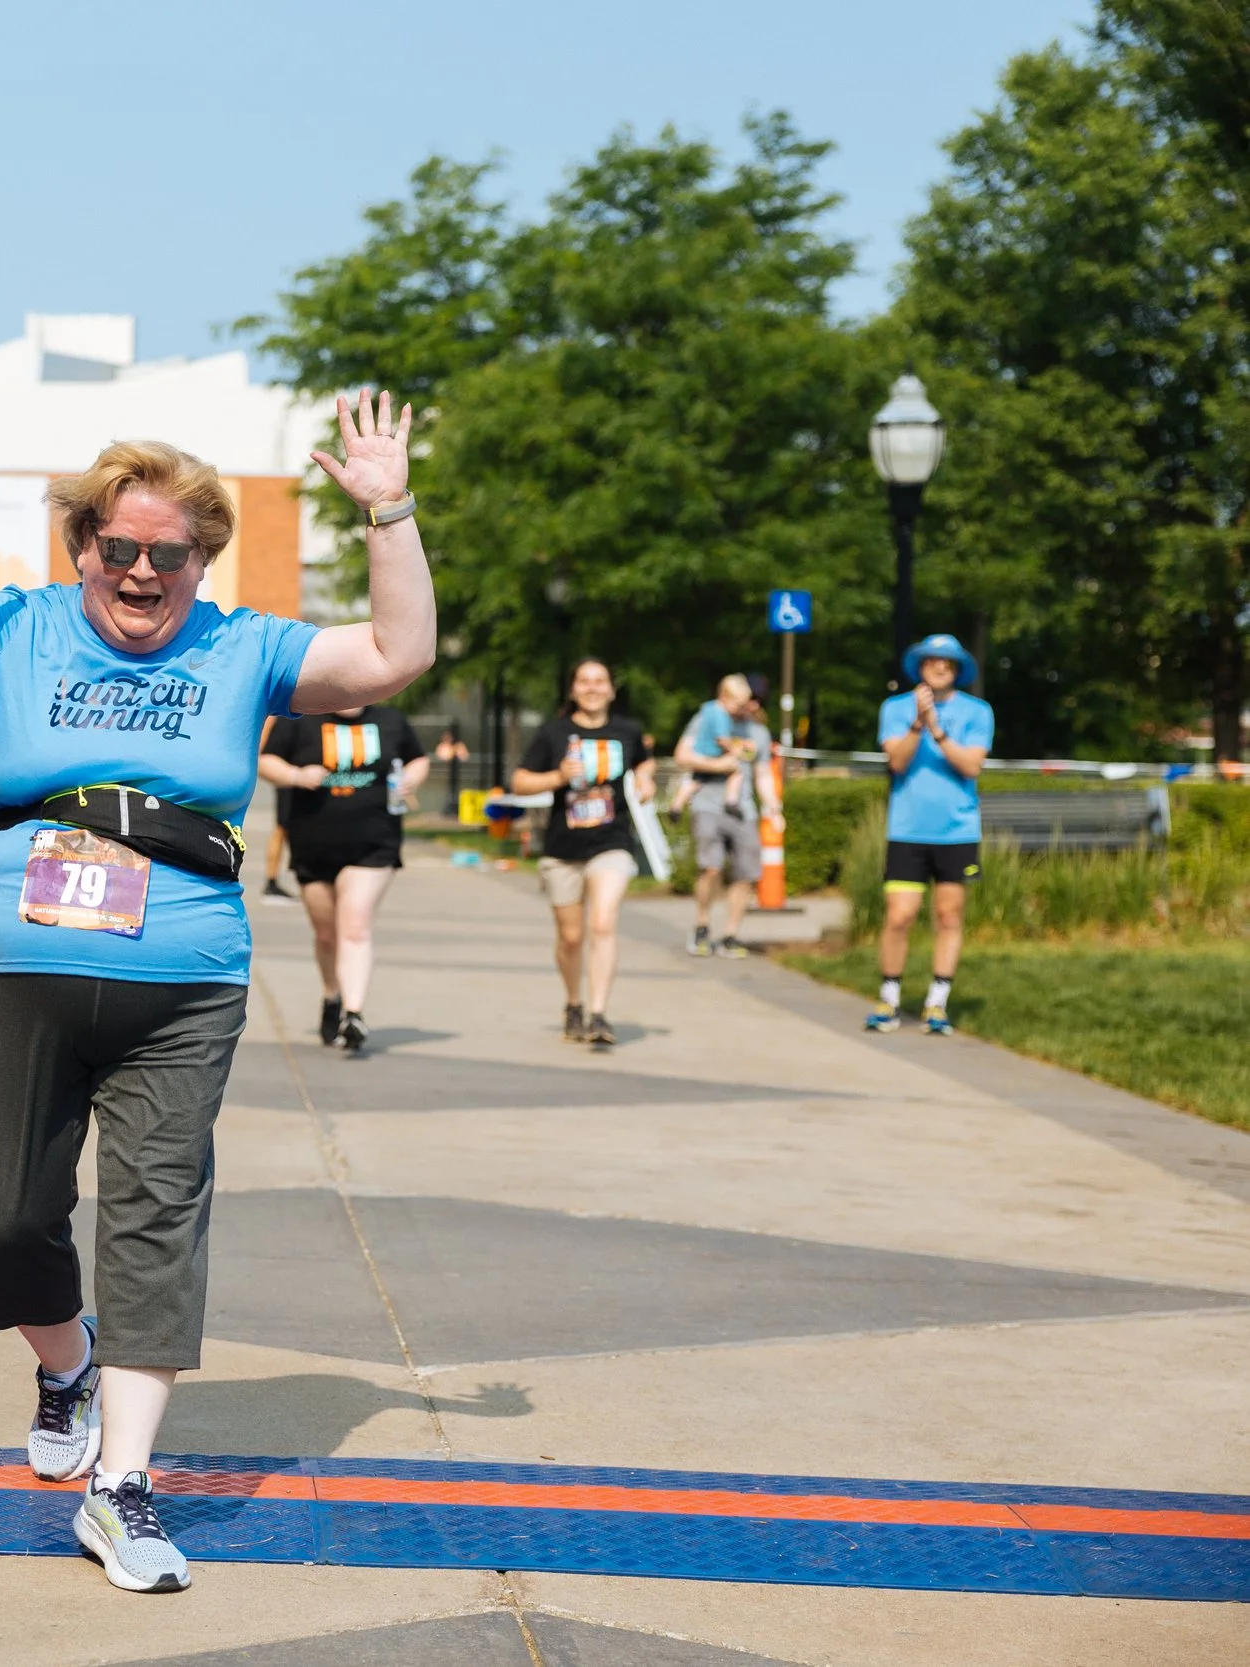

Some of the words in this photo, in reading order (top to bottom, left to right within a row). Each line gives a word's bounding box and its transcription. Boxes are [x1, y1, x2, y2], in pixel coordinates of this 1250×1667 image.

[55, 676, 150, 706] saint
[150, 678, 208, 716] city
[48, 702, 191, 740] running
[60, 862, 107, 907] 79
